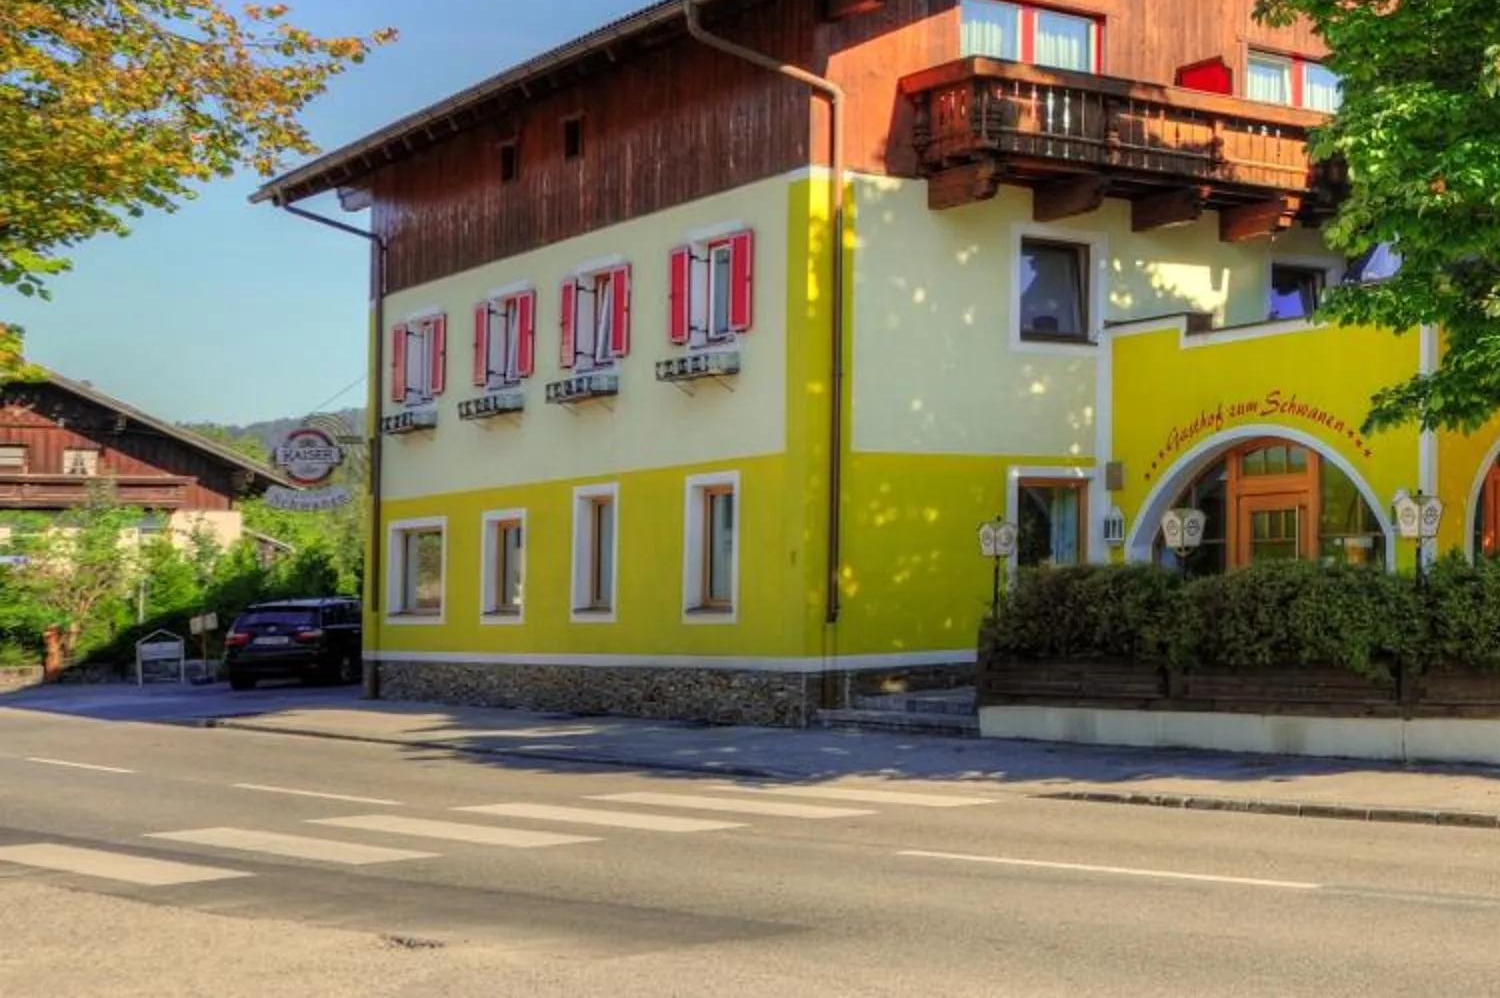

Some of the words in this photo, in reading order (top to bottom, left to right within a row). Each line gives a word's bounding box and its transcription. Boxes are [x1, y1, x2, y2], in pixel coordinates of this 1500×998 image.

[1165, 402, 1223, 450] Gasthof
[1229, 401, 1258, 418] zum
[1259, 389, 1345, 431] Schwanen
[282, 448, 332, 462] KAISER
